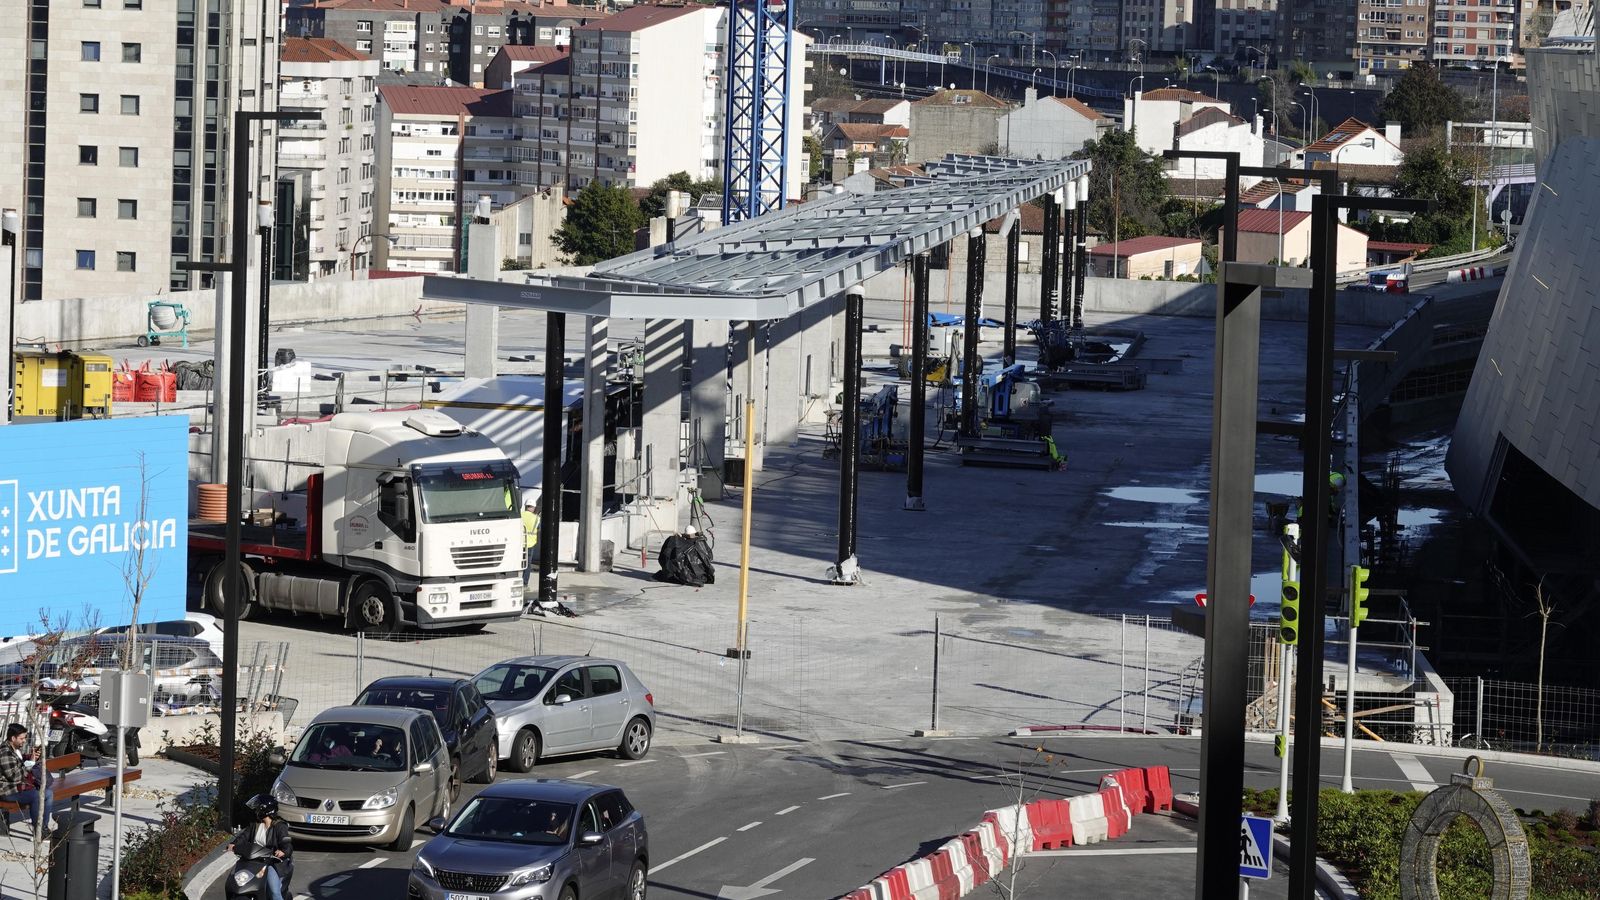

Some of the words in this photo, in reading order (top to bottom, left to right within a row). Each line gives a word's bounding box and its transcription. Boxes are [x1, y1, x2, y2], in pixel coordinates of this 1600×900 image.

[27, 485, 121, 522] XUNTA
[26, 527, 61, 560] DE
[67, 518, 176, 556] GALICIA
